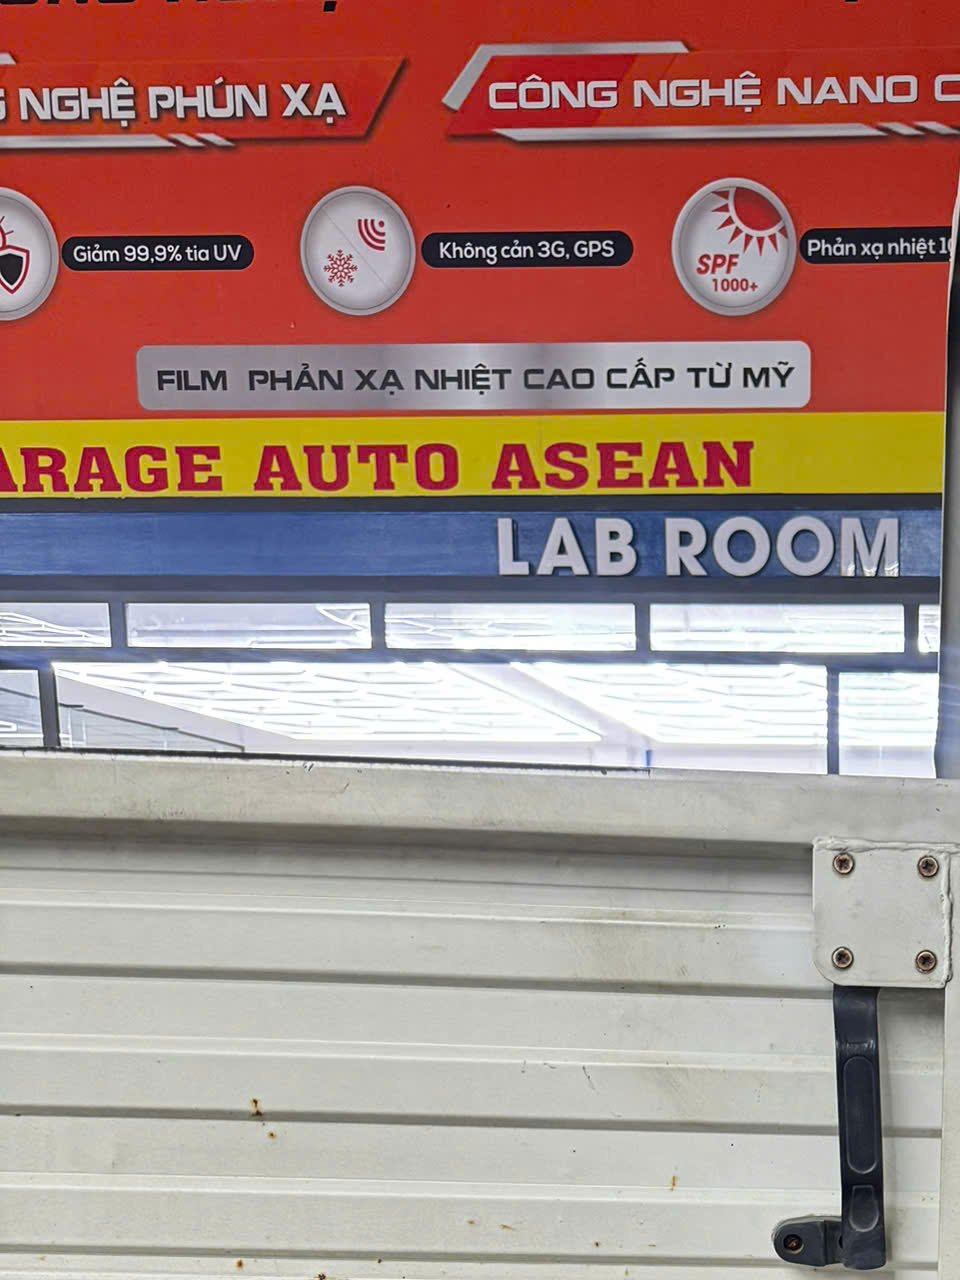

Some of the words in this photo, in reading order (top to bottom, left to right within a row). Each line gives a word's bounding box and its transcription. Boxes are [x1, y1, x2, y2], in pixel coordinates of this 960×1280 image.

[19, 78, 136, 127] NGHỆ
[148, 76, 268, 119] PHÚN
[281, 83, 346, 124] XẠ
[489, 74, 617, 111] CÔNG
[633, 71, 761, 112] NGHỆ
[777, 75, 918, 105] NANO
[73, 244, 119, 263] Giảm
[124, 245, 183, 264] 99,9%
[186, 245, 210, 262] tia
[213, 245, 242, 262] UV
[439, 240, 497, 264] Không
[501, 239, 534, 259] cản
[538, 241, 569, 261] 3G,
[573, 241, 615, 258] GPS
[696, 253, 739, 275] SPF
[807, 237, 856, 257] Phản
[860, 242, 883, 260] xạ
[888, 237, 936, 259] nhiệt
[712, 279, 759, 292] 1000+
[157, 370, 227, 391] FILM
[249, 362, 344, 391] PHẢN
[355, 369, 404, 396] XẠ
[415, 363, 512, 395] NHIỆT
[523, 367, 594, 390] CAO
[606, 358, 675, 389] CẤP
[687, 361, 733, 389] TỪ
[742, 361, 795, 388] MỸ
[253, 443, 459, 492] AUTO
[492, 441, 754, 490] ASEAN
[497, 516, 638, 577] LAB
[664, 516, 900, 578] ROOM
